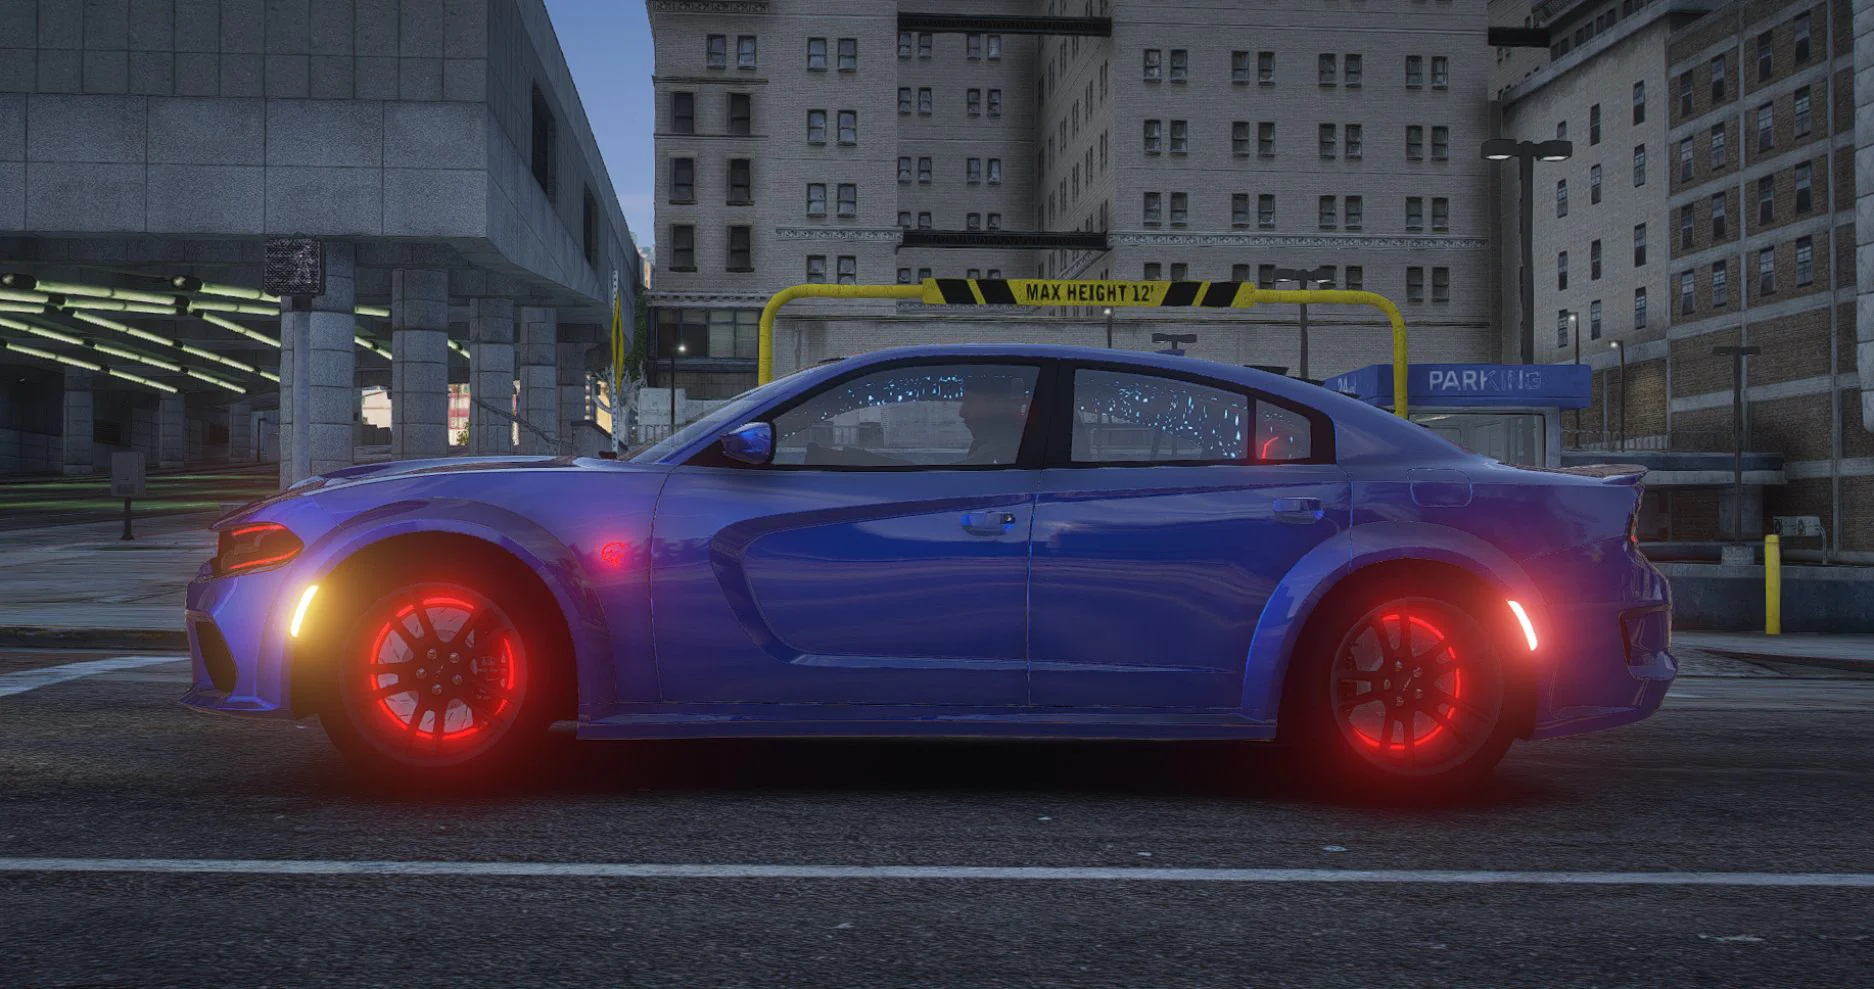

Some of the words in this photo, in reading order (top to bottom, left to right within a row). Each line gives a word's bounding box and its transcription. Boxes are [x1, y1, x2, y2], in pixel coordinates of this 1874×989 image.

[1026, 283, 1060, 301] MAX
[1067, 283, 1126, 302] HEIGHT
[1132, 284, 1154, 302] 12'
[1429, 370, 1541, 391] PARKING
